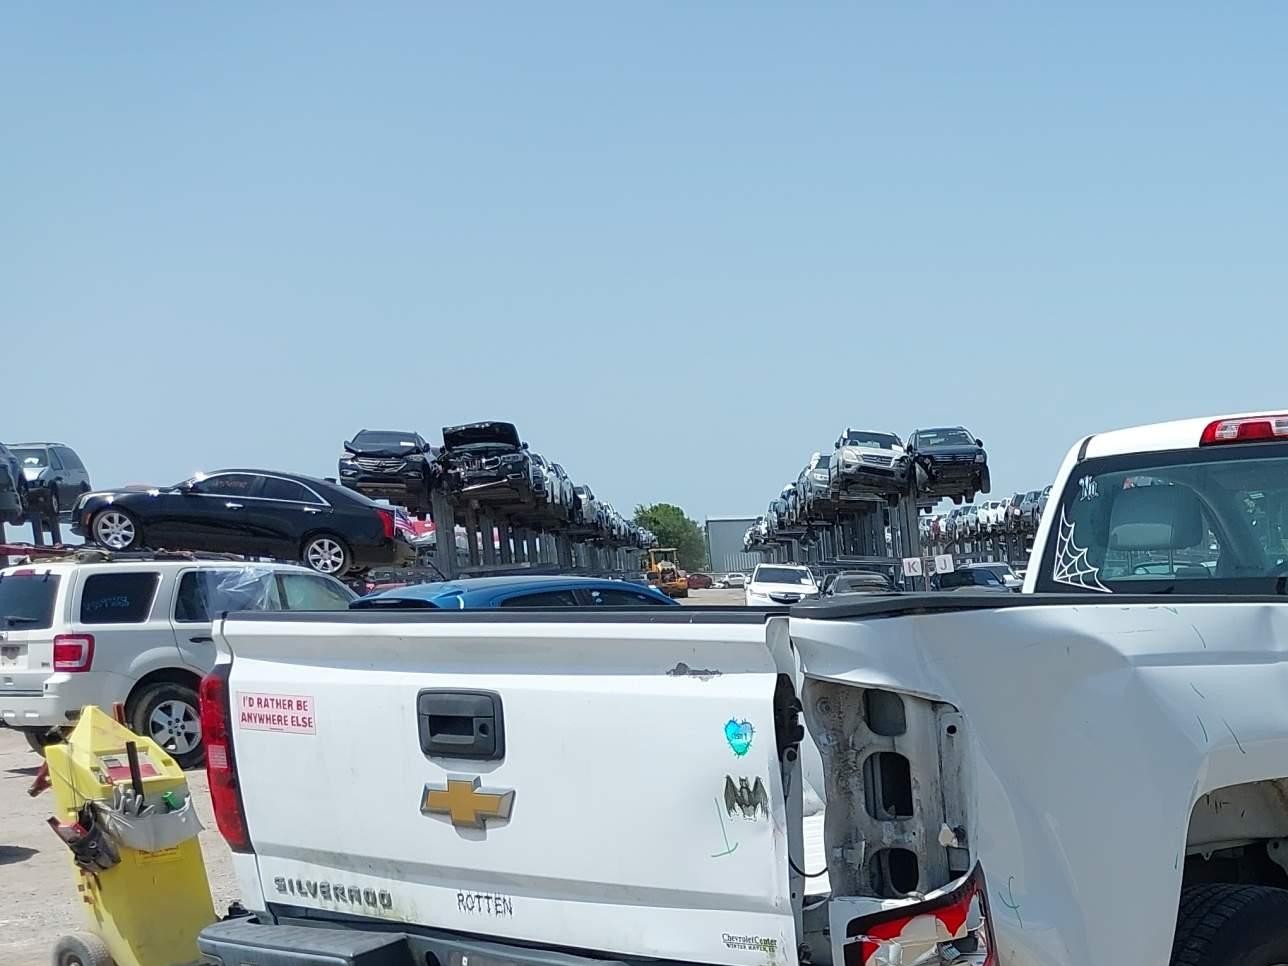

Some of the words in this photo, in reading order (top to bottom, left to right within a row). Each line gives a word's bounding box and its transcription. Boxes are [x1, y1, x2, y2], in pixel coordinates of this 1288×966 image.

[908, 561, 917, 573] K
[941, 559, 948, 570] J
[243, 696, 254, 708] I'D
[257, 697, 293, 711] RATHER
[296, 700, 308, 711] BE
[241, 712, 288, 726] ANYWHERE
[291, 716, 313, 728] ELSE
[273, 876, 393, 910] SILVERADO
[457, 892, 513, 918] ROTTEN
